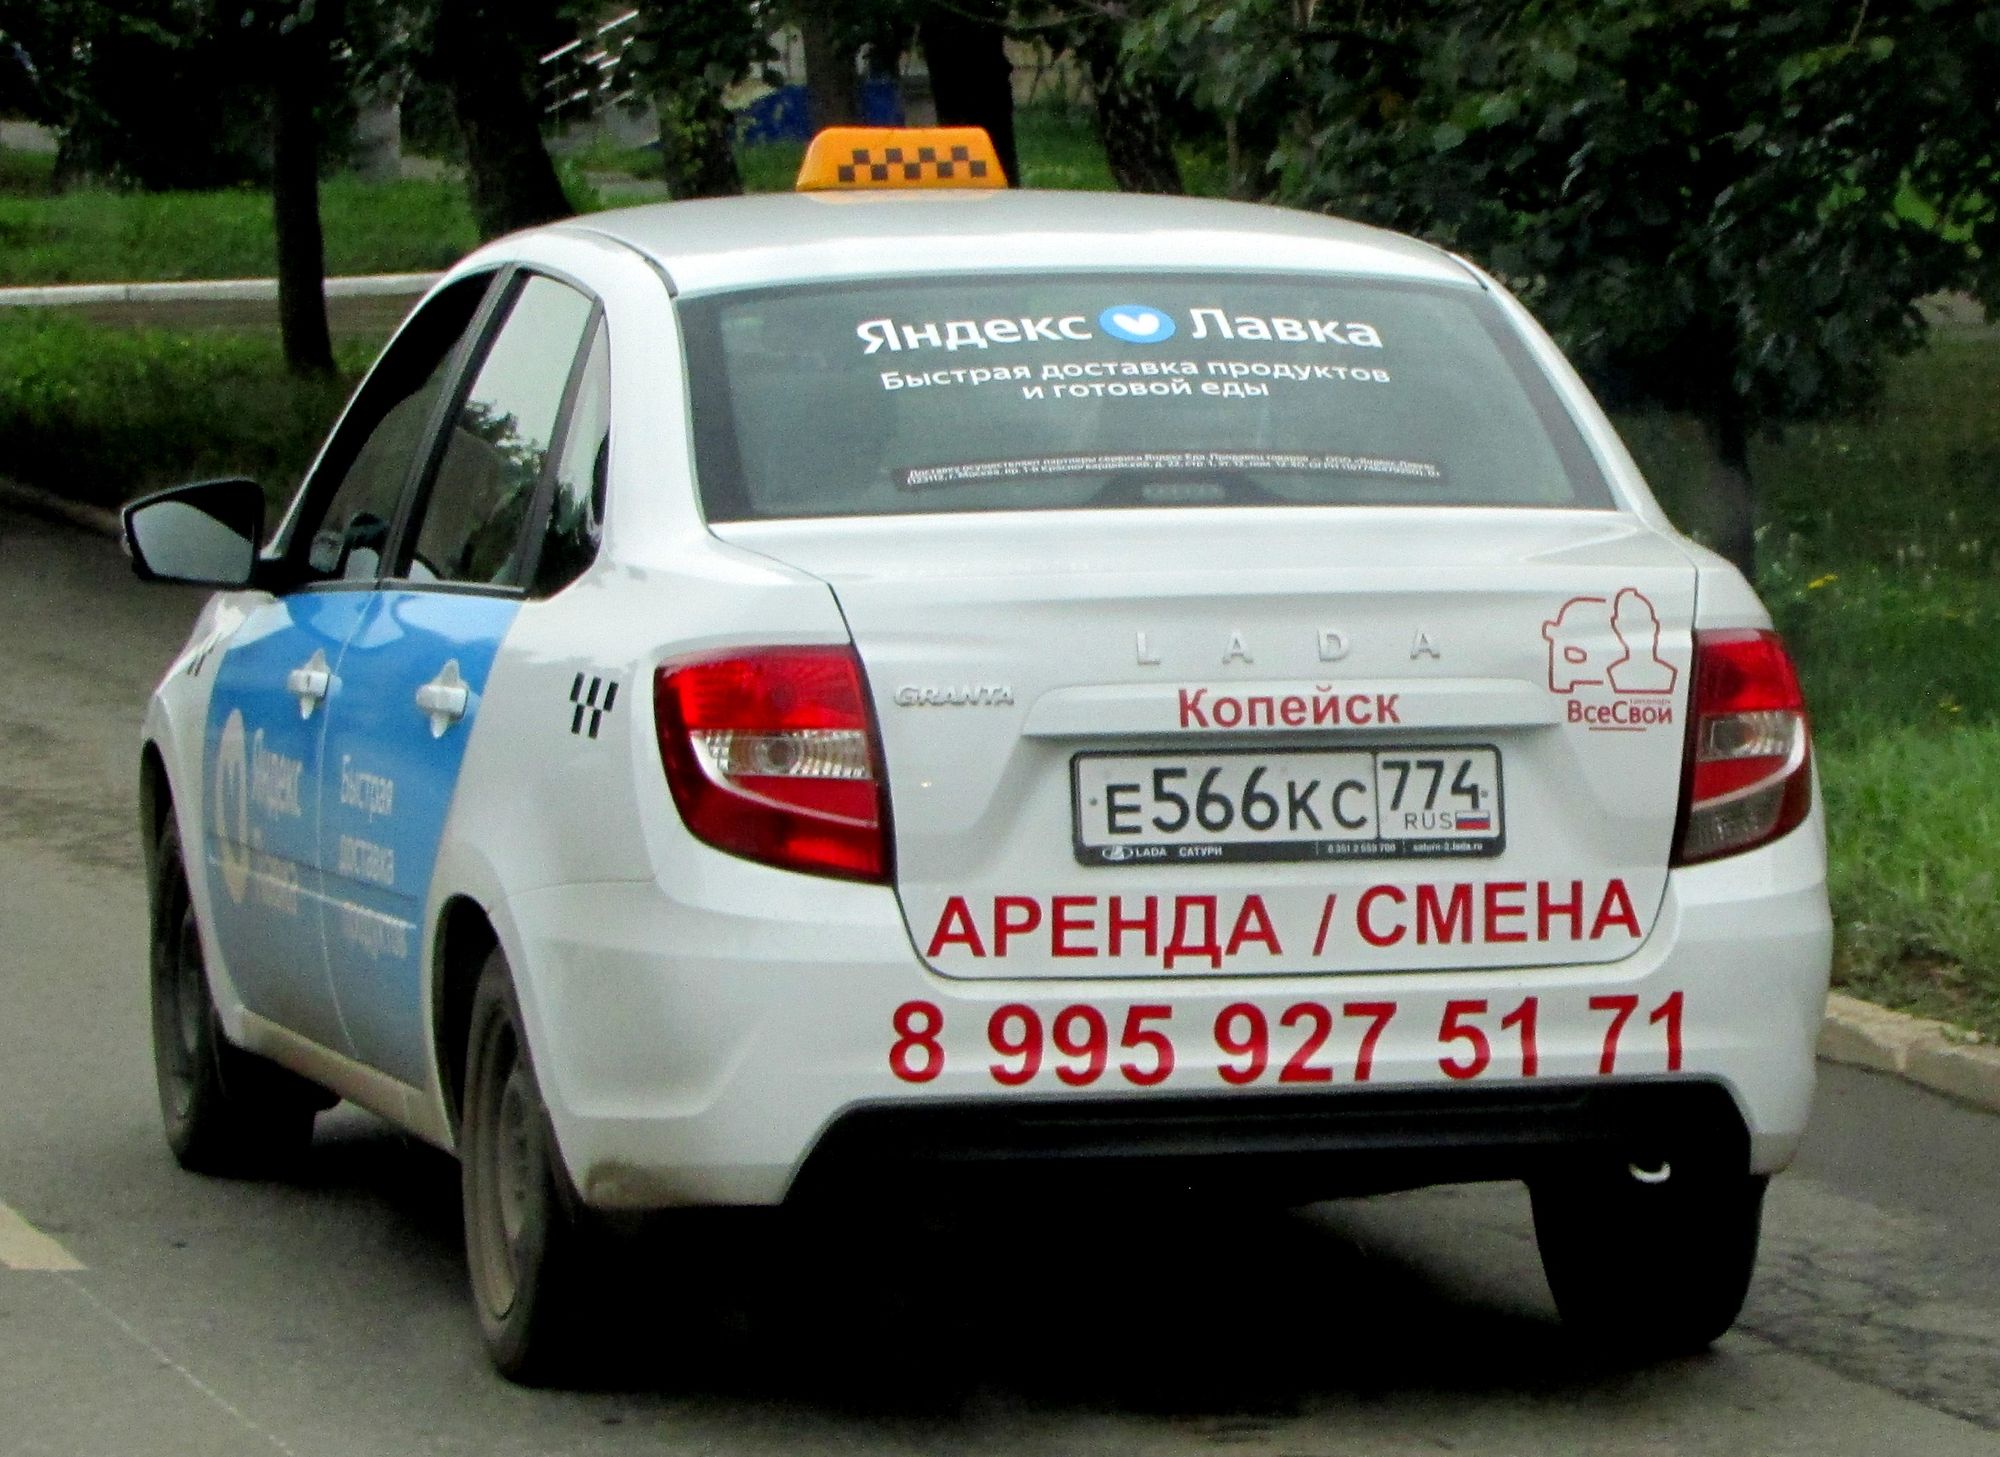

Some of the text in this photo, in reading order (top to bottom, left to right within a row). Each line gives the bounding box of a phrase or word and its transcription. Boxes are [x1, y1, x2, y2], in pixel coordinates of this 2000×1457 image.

[856, 308, 1384, 354] Яндекс Лавка
[881, 361, 1391, 390] Быстрая доставка продуктов
[1022, 378, 1269, 400] и готовой еды
[1136, 629, 1441, 665] LADA
[894, 686, 1014, 706] GRANTA
[1178, 685, 1400, 728] Копейск
[1567, 700, 1673, 724] ВсеСвои
[1381, 758, 1482, 813] 774
[1404, 810, 1453, 830] RUS
[1136, 846, 1167, 857] LADA
[1179, 846, 1222, 857] САТУРН
[929, 879, 1641, 968] АРЕНДА / СМЕНА
[889, 992, 1683, 1086] 8 995 927 51 71
